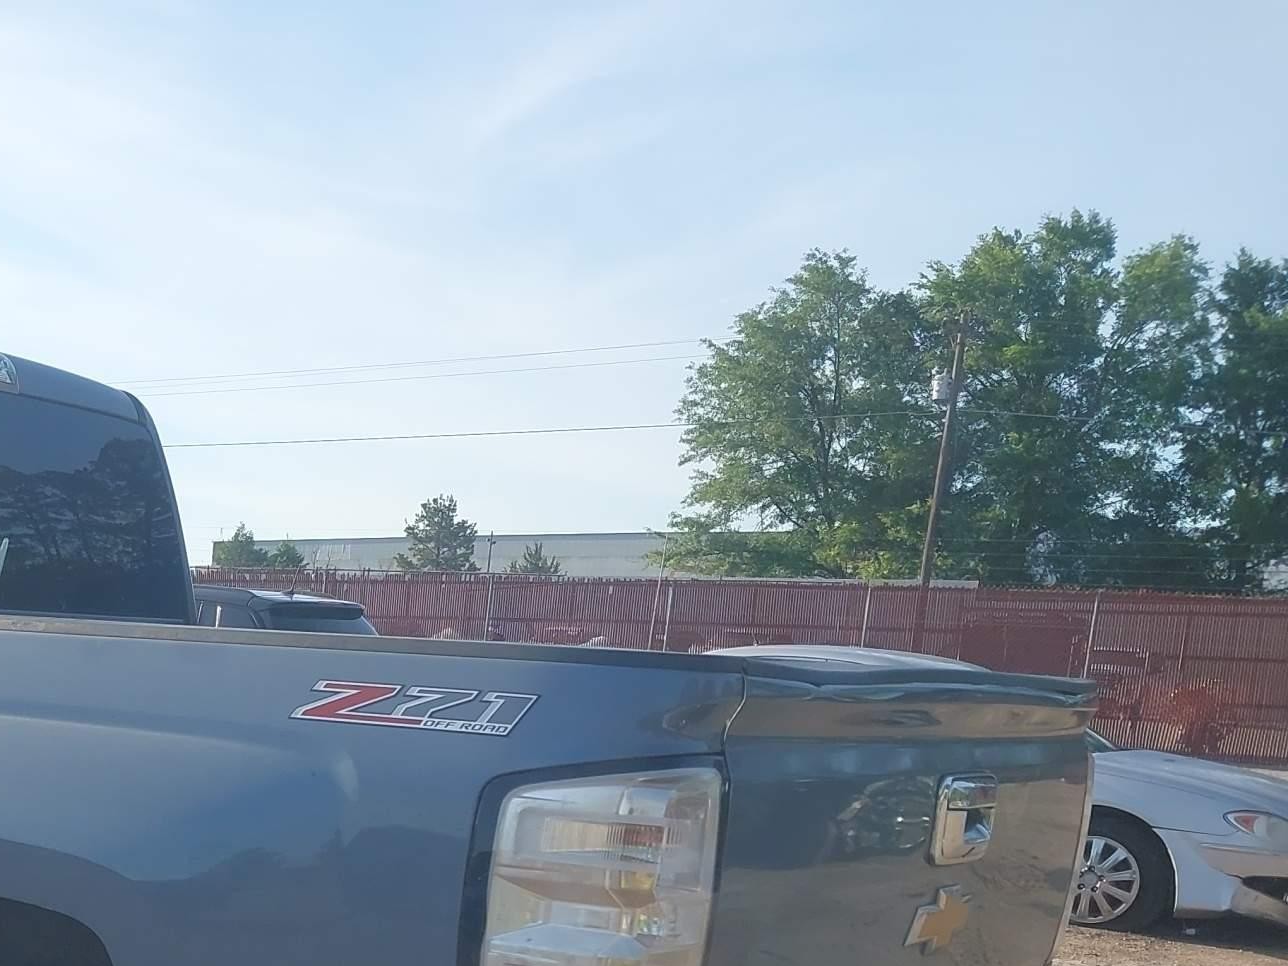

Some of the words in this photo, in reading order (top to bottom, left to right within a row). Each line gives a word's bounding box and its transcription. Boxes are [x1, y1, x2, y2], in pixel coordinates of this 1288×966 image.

[289, 680, 541, 727] Z71
[423, 719, 458, 730] OFF
[459, 722, 509, 734] ROAD
